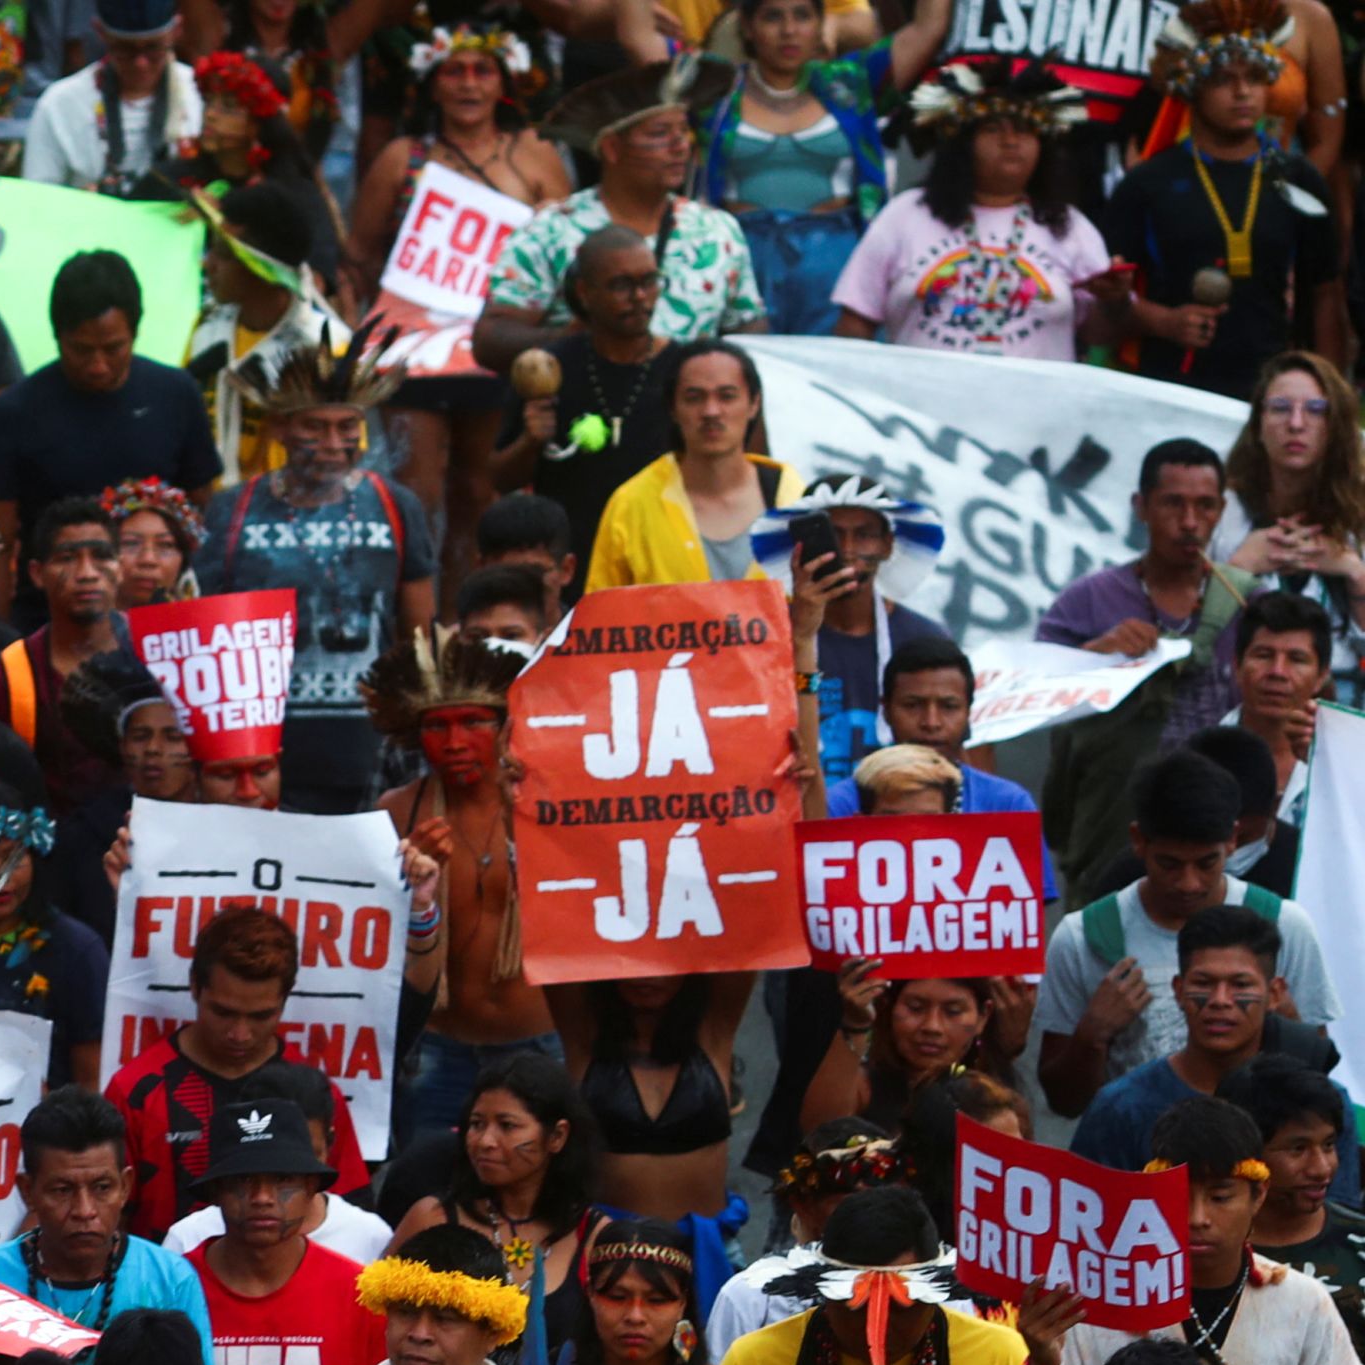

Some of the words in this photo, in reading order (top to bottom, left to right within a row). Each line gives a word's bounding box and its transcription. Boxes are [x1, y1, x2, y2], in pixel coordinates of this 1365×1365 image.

[548, 613, 769, 657] EMARCAÇÃO
[582, 652, 715, 780] JÁ
[536, 786, 777, 829] DEMARCAÇÃO
[252, 857, 283, 891] O
[594, 822, 725, 943] JÁ
[803, 836, 1036, 905] FORA
[804, 898, 1039, 957] GRILAGEM!
[959, 1143, 1182, 1258] FORA
[957, 1207, 1186, 1308] GRILAGEM!
